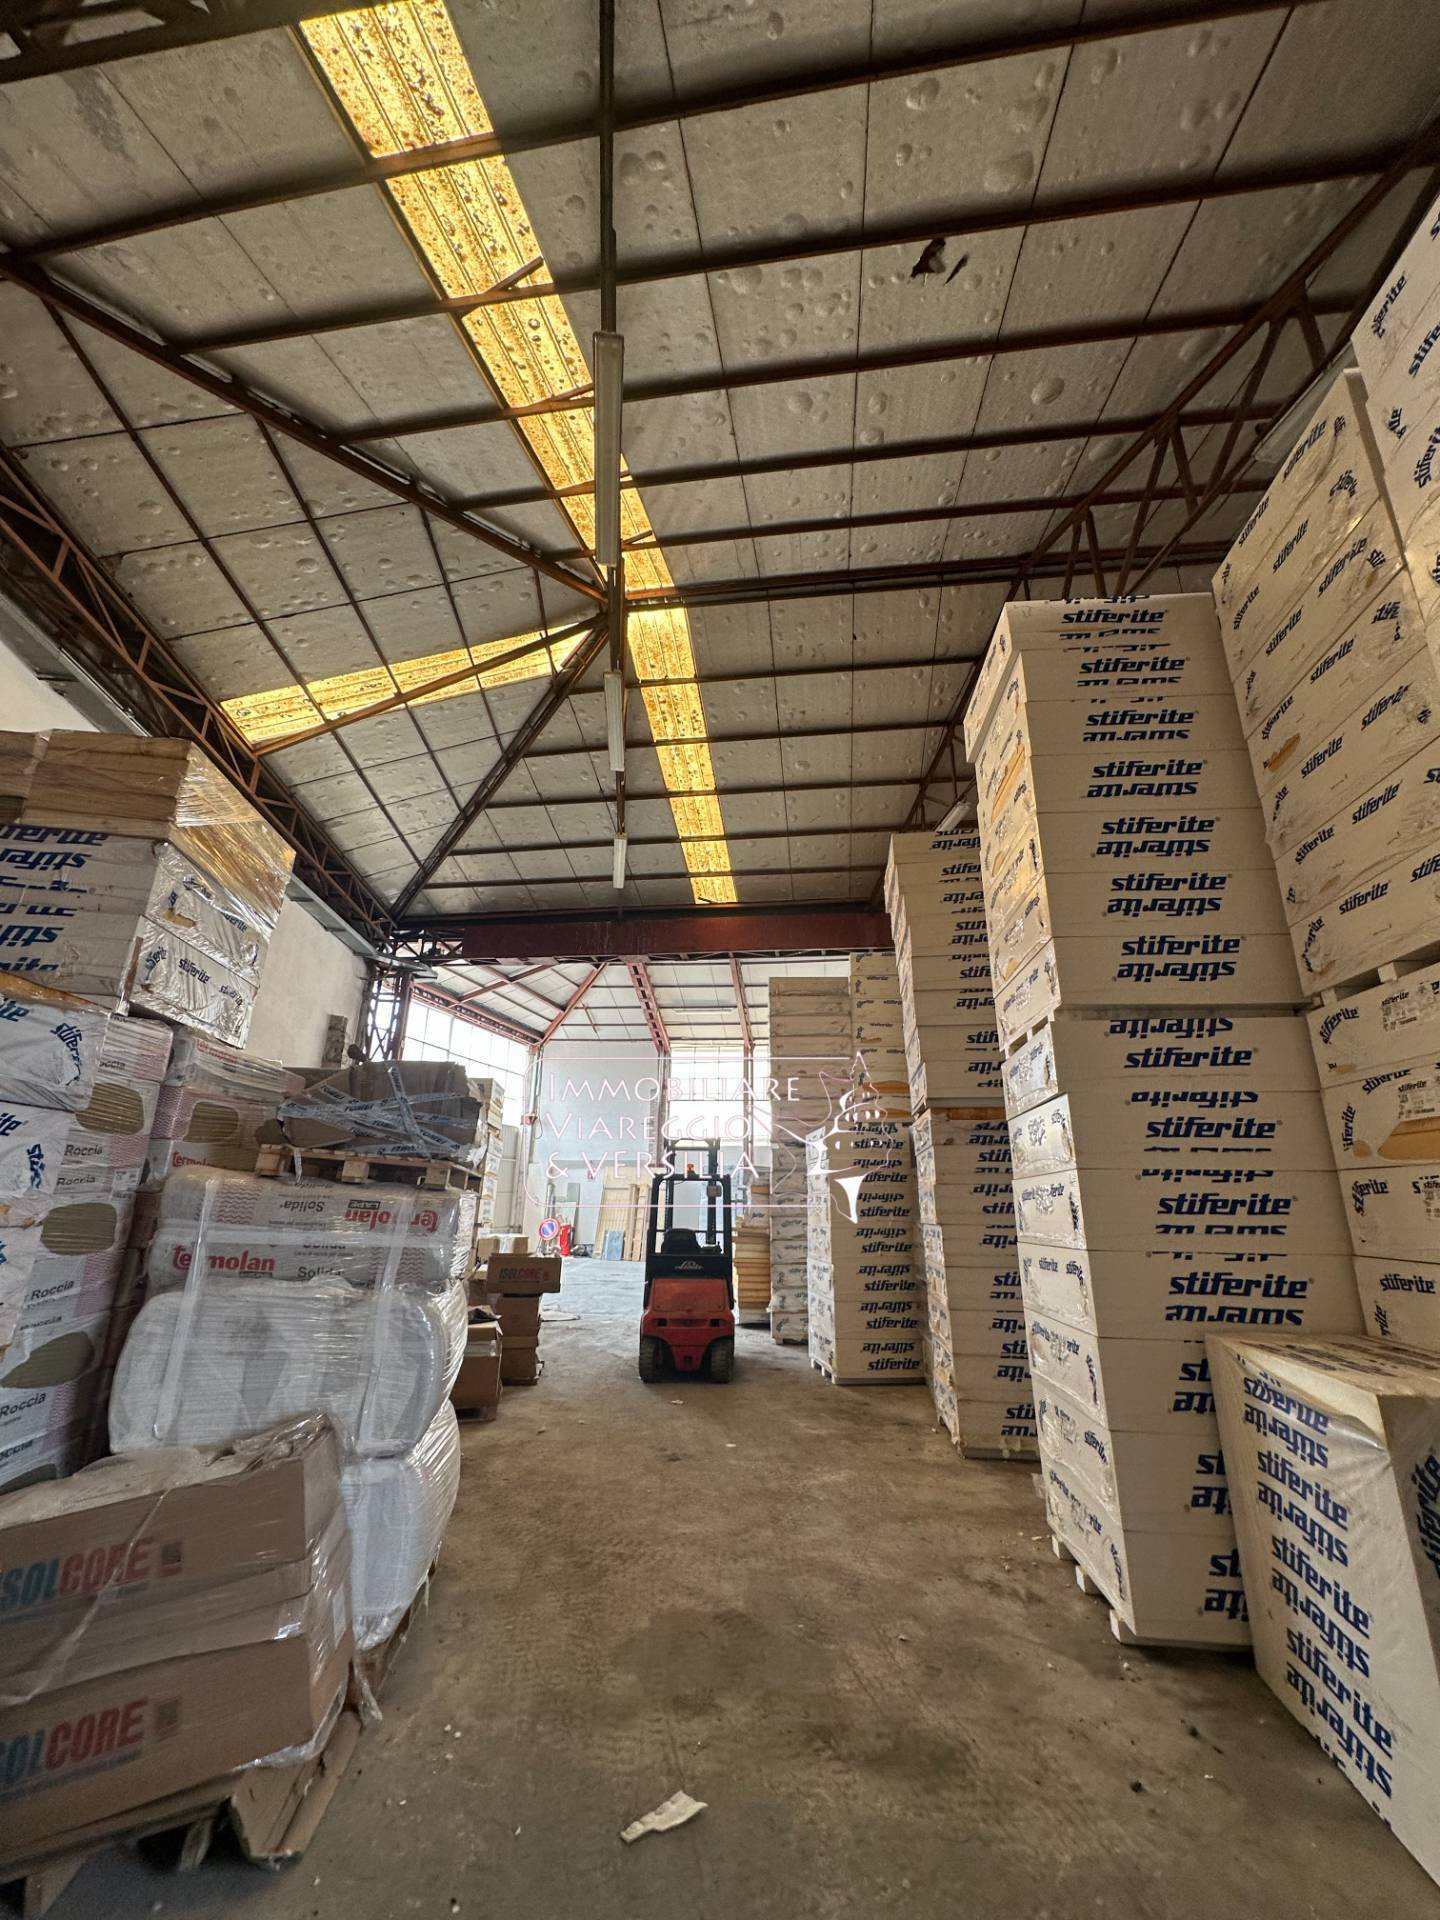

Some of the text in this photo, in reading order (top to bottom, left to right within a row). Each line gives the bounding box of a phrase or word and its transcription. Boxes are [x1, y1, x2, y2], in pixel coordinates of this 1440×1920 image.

[1272, 517, 1310, 574] stiferite
[1061, 609, 1166, 624] stiferite
[1265, 606, 1303, 657] stiferite
[1079, 656, 1186, 674] stiferite
[1310, 638, 1355, 685] stiferite
[1086, 709, 1195, 726] stiferite
[1301, 735, 1344, 779] stiferite
[1091, 759, 1203, 778] stiferite
[1352, 782, 1400, 825] stiferite
[1101, 816, 1216, 835] stiferite
[1096, 839, 1211, 858] stiferite
[1295, 825, 1336, 865] stiferite
[1111, 872, 1227, 892] stiferite
[1107, 897, 1223, 917] stiferite
[1339, 881, 1391, 915] stiferite
[1121, 935, 1241, 956] stiferite
[179, 958, 211, 984] stiferite
[1117, 961, 1238, 983] stiferite
[1124, 1046, 1253, 1068] stiferite
[1146, 1116, 1277, 1139] stiferite
[64, 1144, 103, 1157] Roccia
[56, 1175, 96, 1187] Roccia
[863, 1171, 908, 1183] tiferite
[283, 1200, 325, 1213] Solida
[860, 1206, 911, 1217] stiferite
[1157, 1193, 1292, 1216] stiferite
[343, 1210, 439, 1233] terolan
[173, 1245, 275, 1272] temolan
[861, 1243, 912, 1254] stiferite
[31, 1280, 75, 1300] Roccia
[864, 1279, 916, 1291] stiferite
[1168, 1271, 1309, 1299] stiferite
[1380, 1273, 1437, 1294] stiferite
[866, 1319, 919, 1330] stiferite
[868, 1358, 921, 1371] stiferite
[0, 1392, 47, 1418] Roccia
[1257, 1451, 1349, 1532] stiferite
[1257, 1481, 1349, 1568] stiferite
[1272, 1535, 1371, 1640] stiferite
[1271, 1567, 1371, 1679] stiferite
[1286, 1627, 1393, 1761] stiferite
[1286, 1661, 1393, 1800] stiferite
